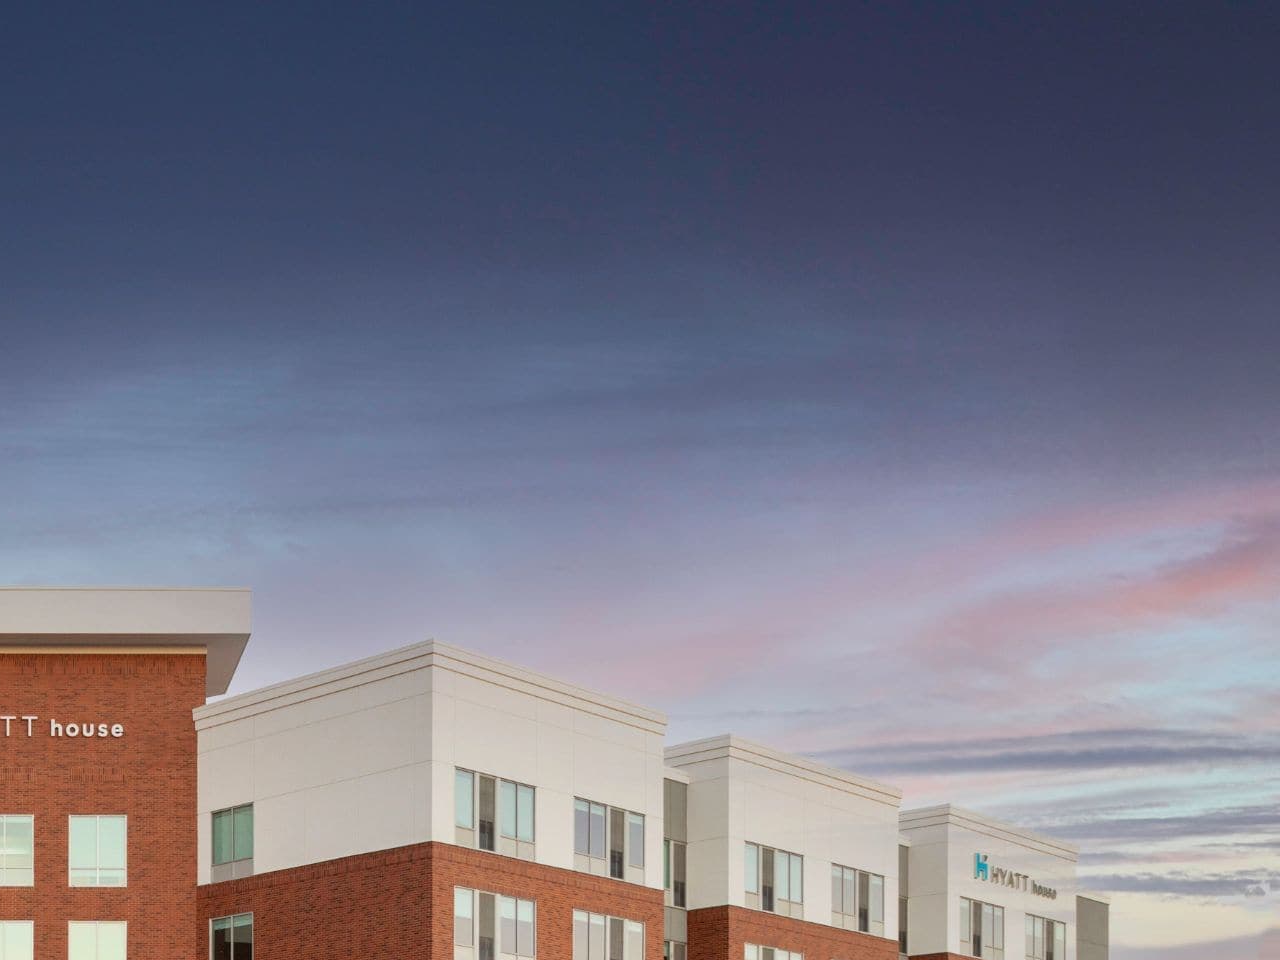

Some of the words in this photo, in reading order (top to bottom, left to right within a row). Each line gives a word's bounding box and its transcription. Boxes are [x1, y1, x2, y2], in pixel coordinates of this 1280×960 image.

[49, 718, 125, 738] house
[990, 866, 1029, 891] HYATT
[1031, 880, 1057, 900] house
